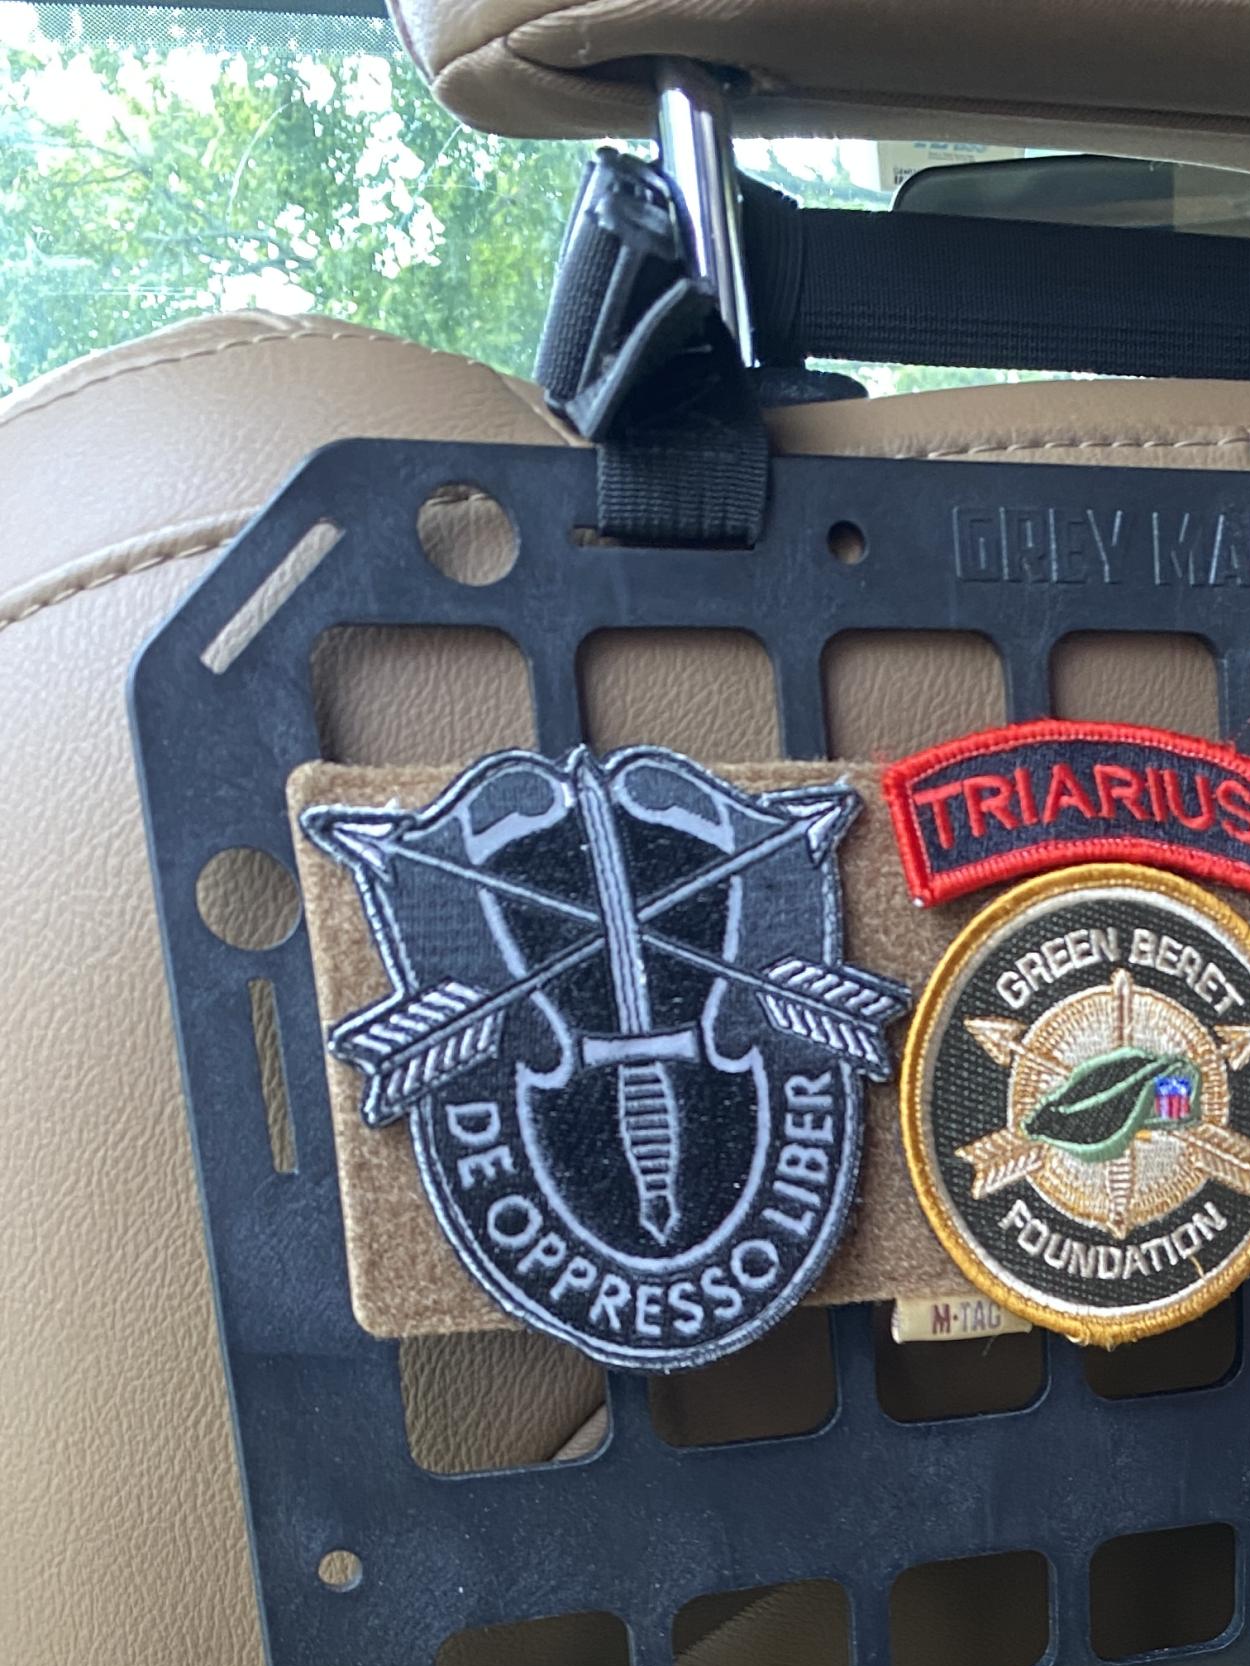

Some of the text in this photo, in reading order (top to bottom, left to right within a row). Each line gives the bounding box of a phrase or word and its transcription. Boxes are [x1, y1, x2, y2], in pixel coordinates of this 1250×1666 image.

[994, 928, 1244, 1017] GREEN BERET
[445, 1071, 836, 1338] DE OPPRESSO LIBER
[998, 1199, 1229, 1282] FOUNDATION
